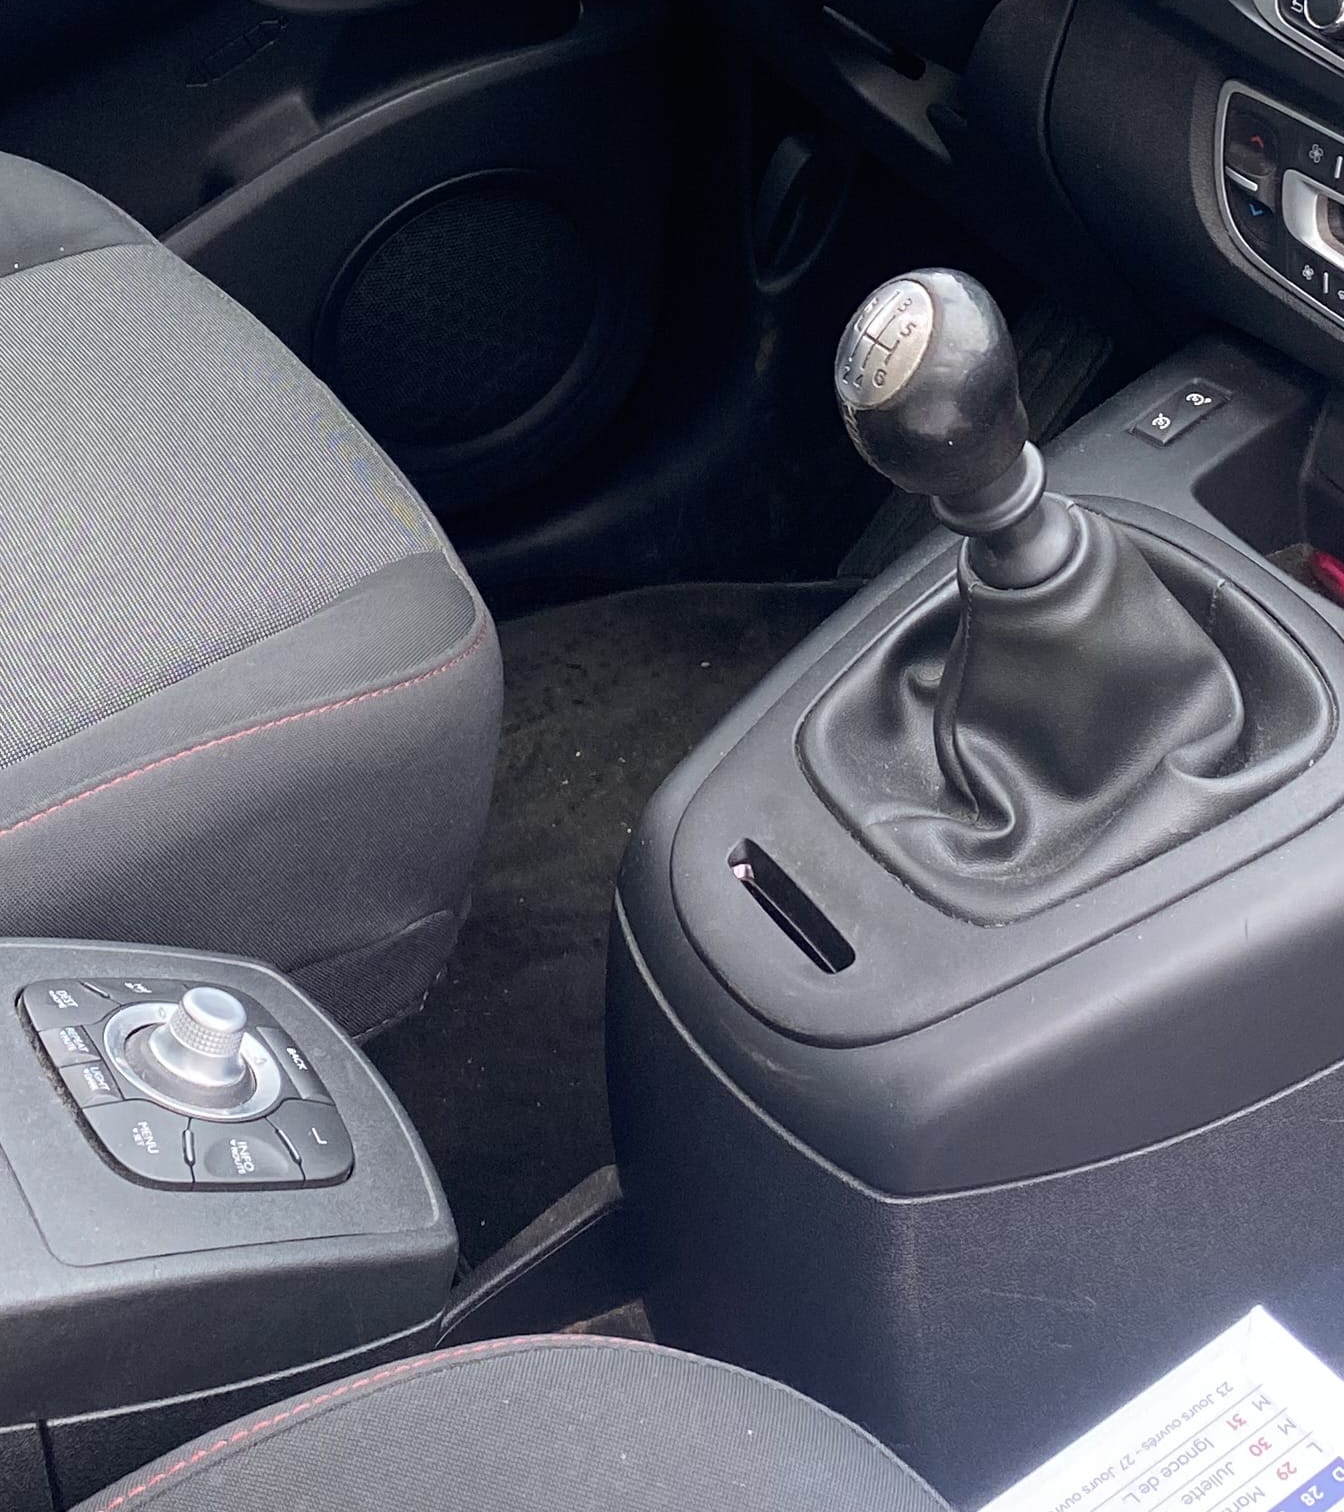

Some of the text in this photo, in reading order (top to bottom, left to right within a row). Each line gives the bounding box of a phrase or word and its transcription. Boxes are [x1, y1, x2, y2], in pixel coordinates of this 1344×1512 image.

[900, 321, 918, 338] 5
[872, 368, 888, 388] 6
[90, 1066, 111, 1091] LIGHT
[138, 1121, 159, 1155] MENU
[237, 1141, 255, 1172] INFO
[1215, 1381, 1234, 1397] 23
[1181, 1393, 1215, 1421] Jours
[1251, 1394, 1272, 1412] M
[1226, 1412, 1248, 1431] 31
[1306, 1441, 1324, 1453] L
[1119, 1454, 1136, 1471] 27
[1160, 1437, 1215, 1479] Ignace
[1180, 1417, 1297, 1506] M 30 Juliette
[1081, 1466, 1116, 1494] Jours
[1276, 1461, 1298, 1481] 29
[1138, 1476, 1160, 1495] de
[1300, 1485, 1325, 1506] 28
